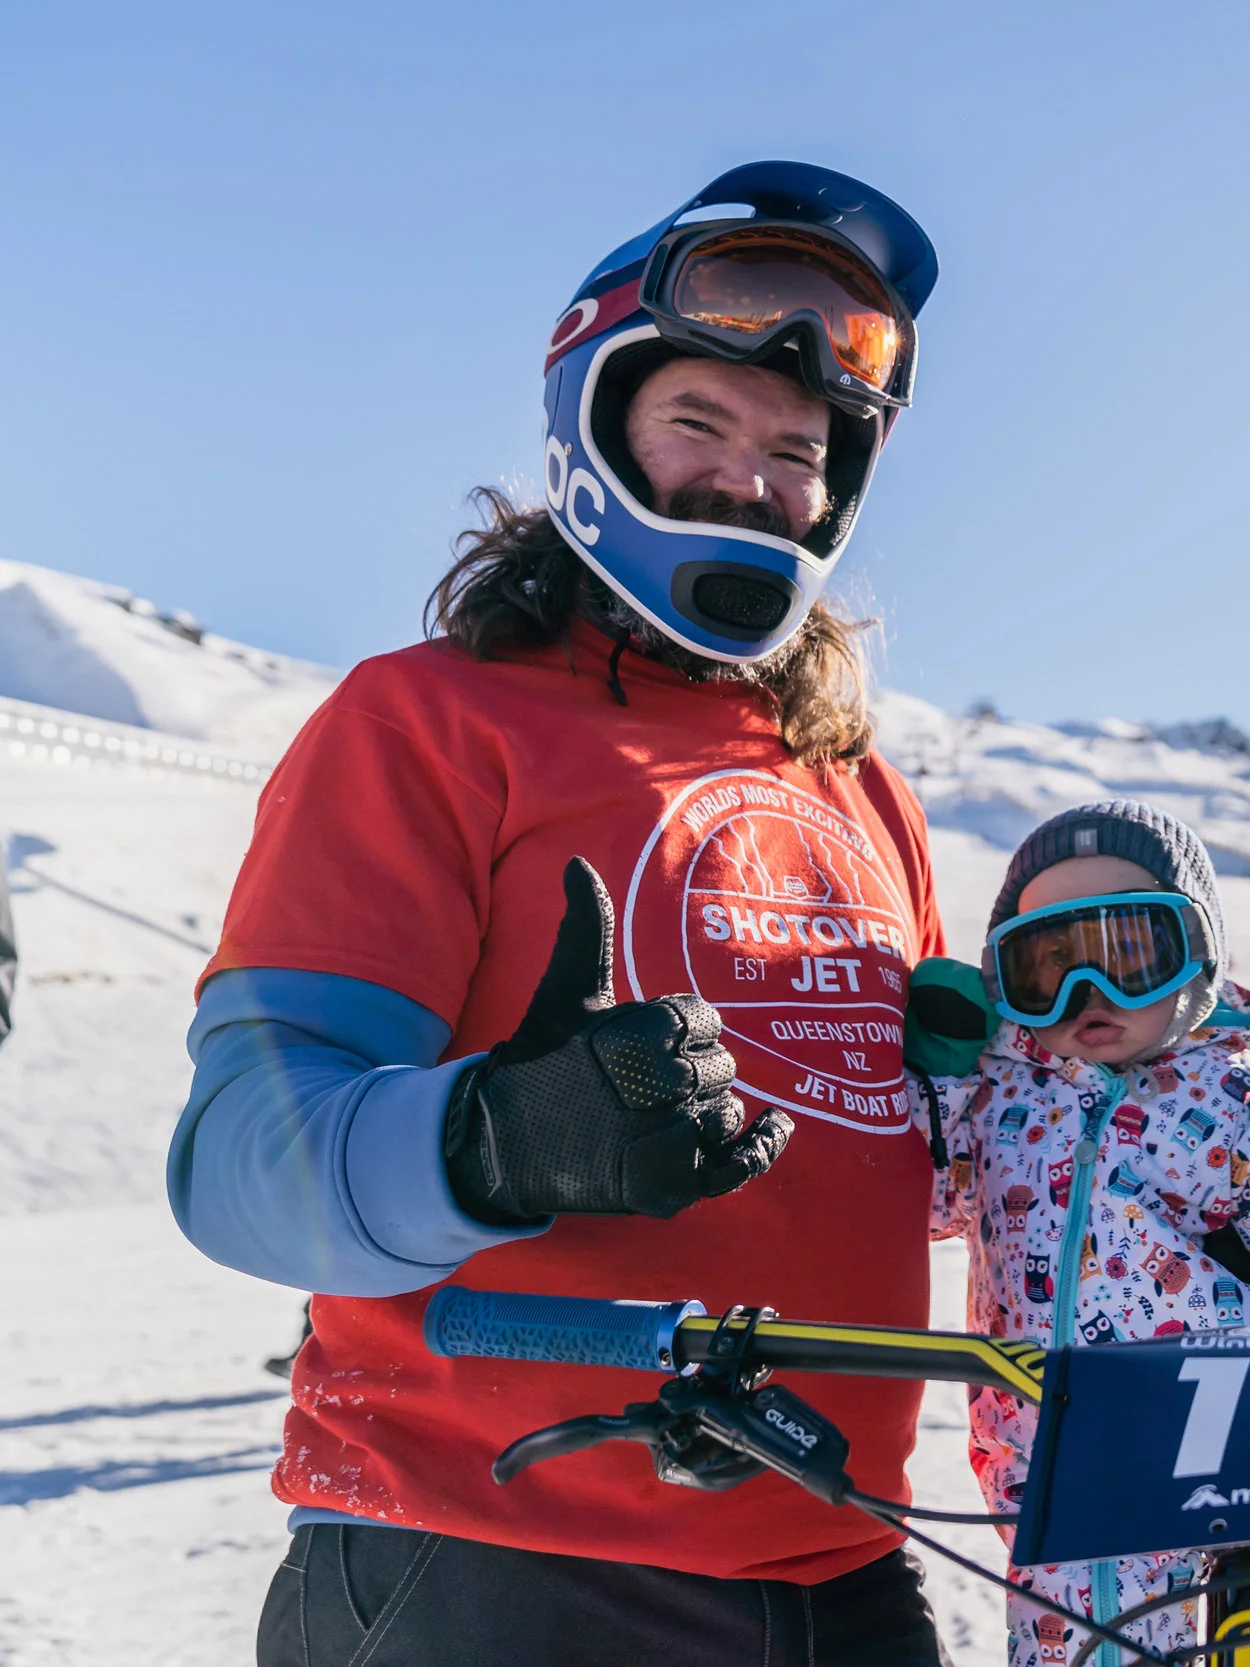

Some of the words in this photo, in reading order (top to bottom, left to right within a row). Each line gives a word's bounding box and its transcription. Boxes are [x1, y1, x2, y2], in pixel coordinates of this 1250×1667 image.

[544, 420, 605, 546] OC
[680, 785, 742, 833] WORLDS
[739, 785, 789, 809] MOST
[793, 797, 875, 862] EXCITING
[702, 903, 907, 962] SHOTOVER
[734, 956, 767, 981] EST
[790, 956, 862, 993] JET
[877, 966, 903, 994] 1965
[842, 1050, 872, 1071] NZ
[794, 1073, 837, 1104] JET
[841, 1088, 889, 1117] BOAT
[890, 1086, 910, 1116] RID
